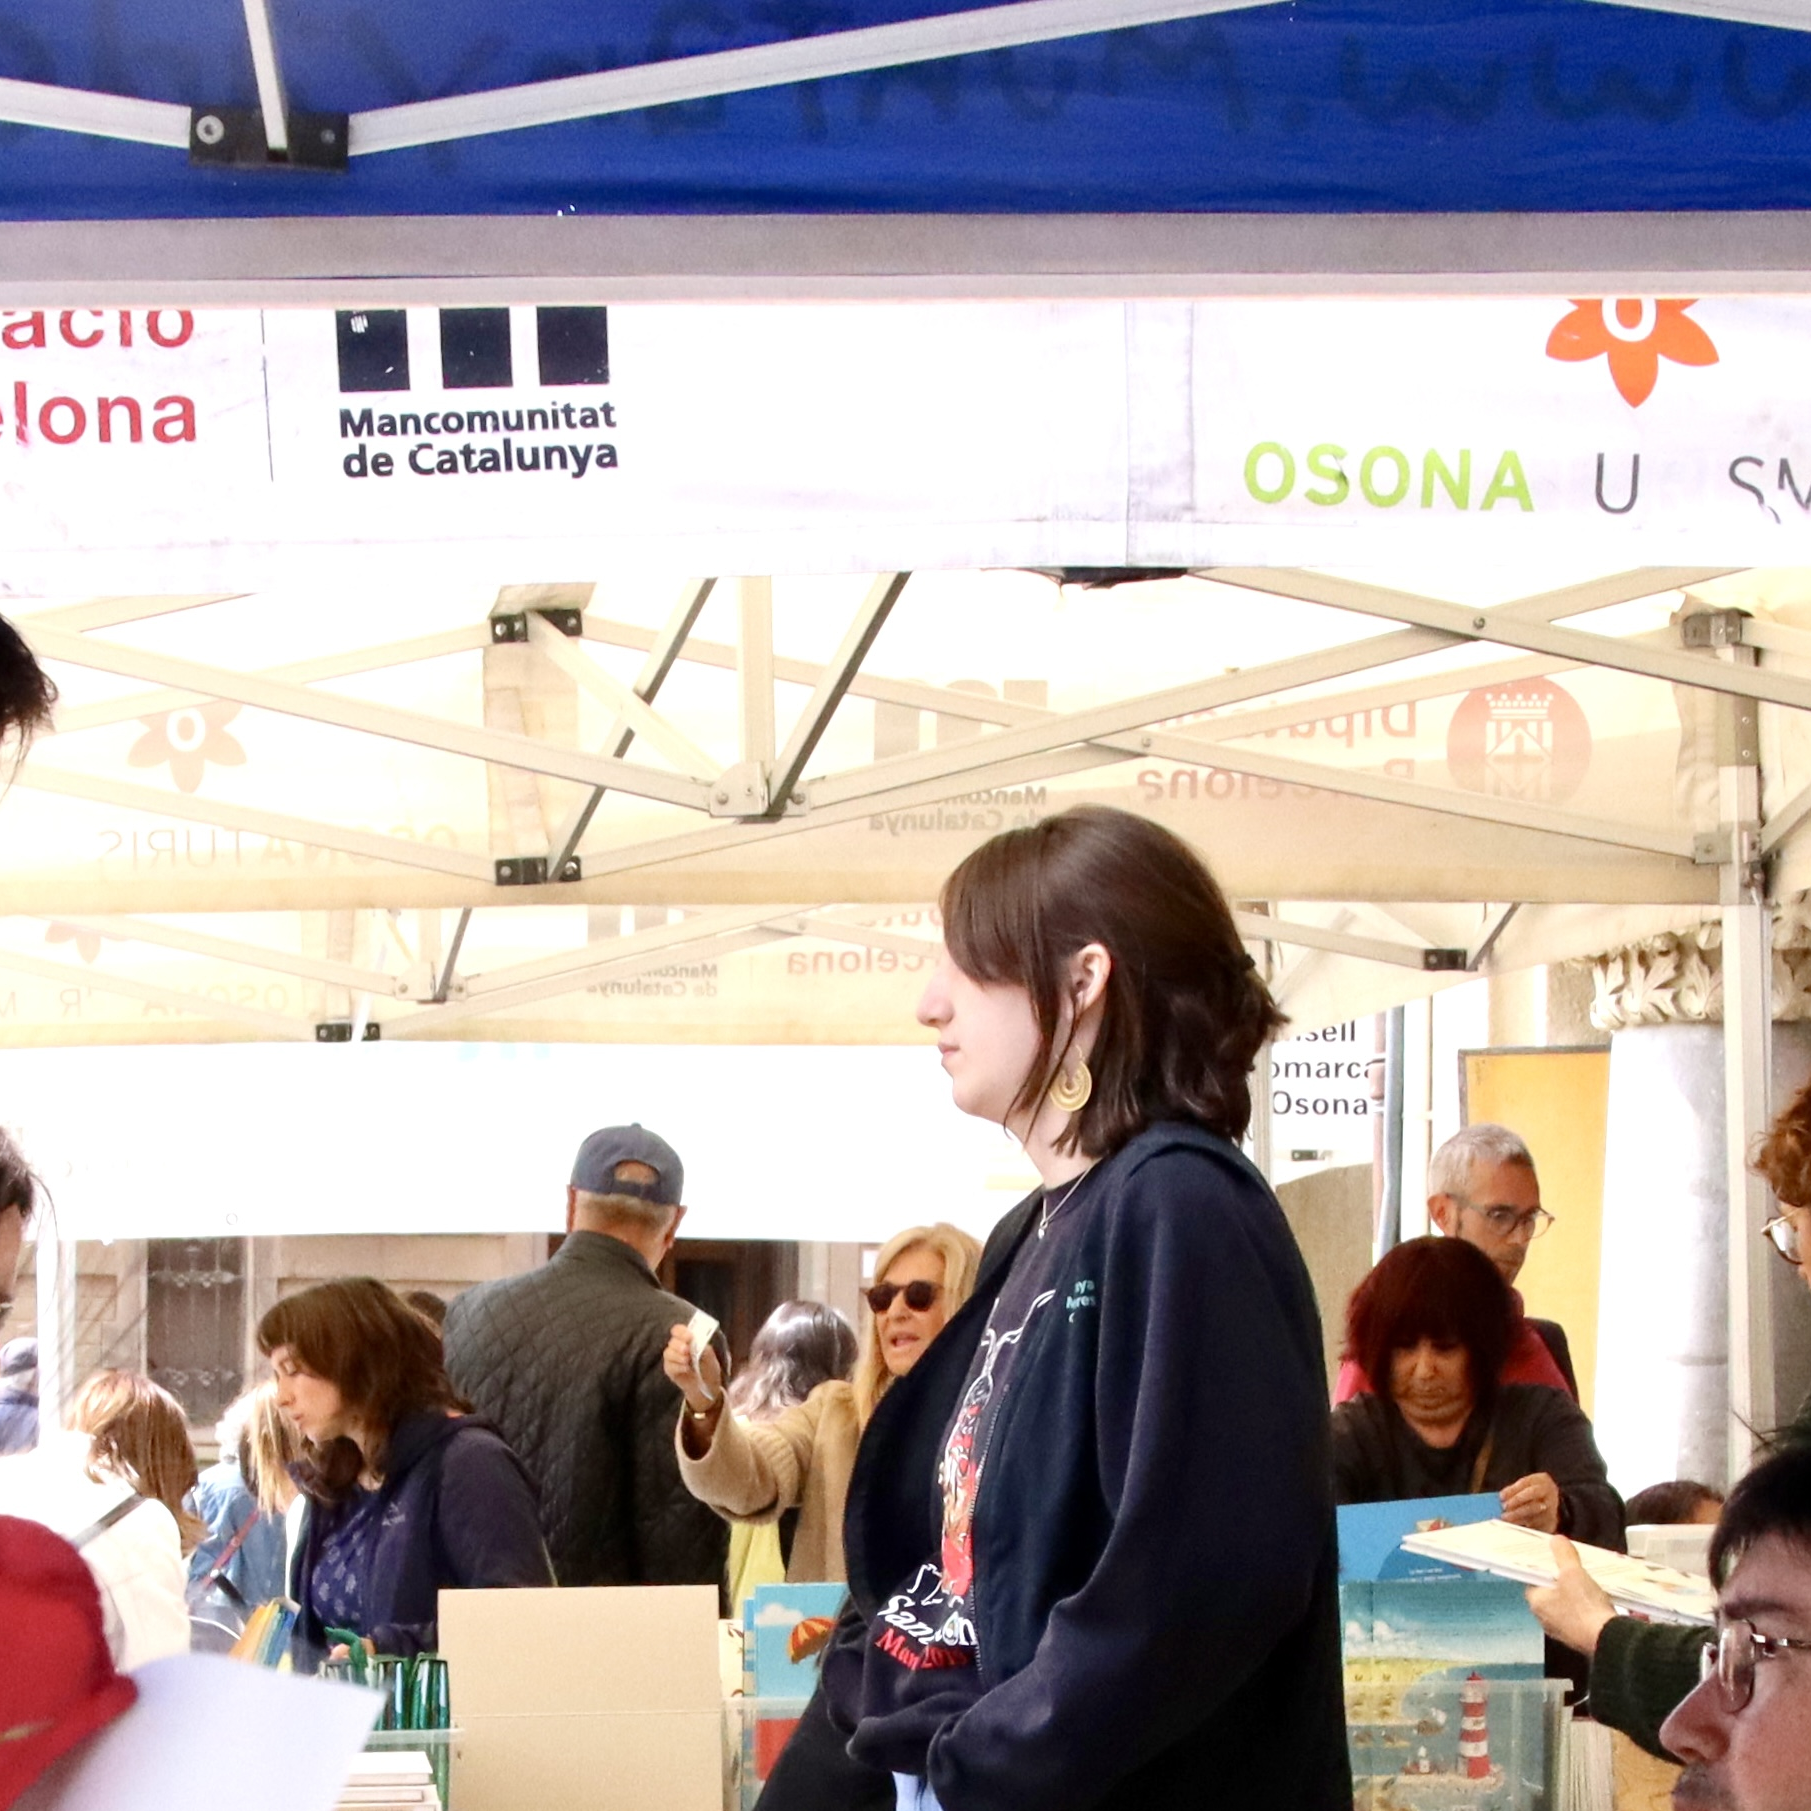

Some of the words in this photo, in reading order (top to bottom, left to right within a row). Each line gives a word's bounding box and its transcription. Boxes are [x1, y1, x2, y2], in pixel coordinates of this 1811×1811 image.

[338, 400, 618, 440] Mancomunitat
[342, 440, 394, 478] de
[407, 436, 620, 477] Catalunya
[1242, 440, 1535, 513] OSONA
[1272, 1090, 1368, 1115] Osona
